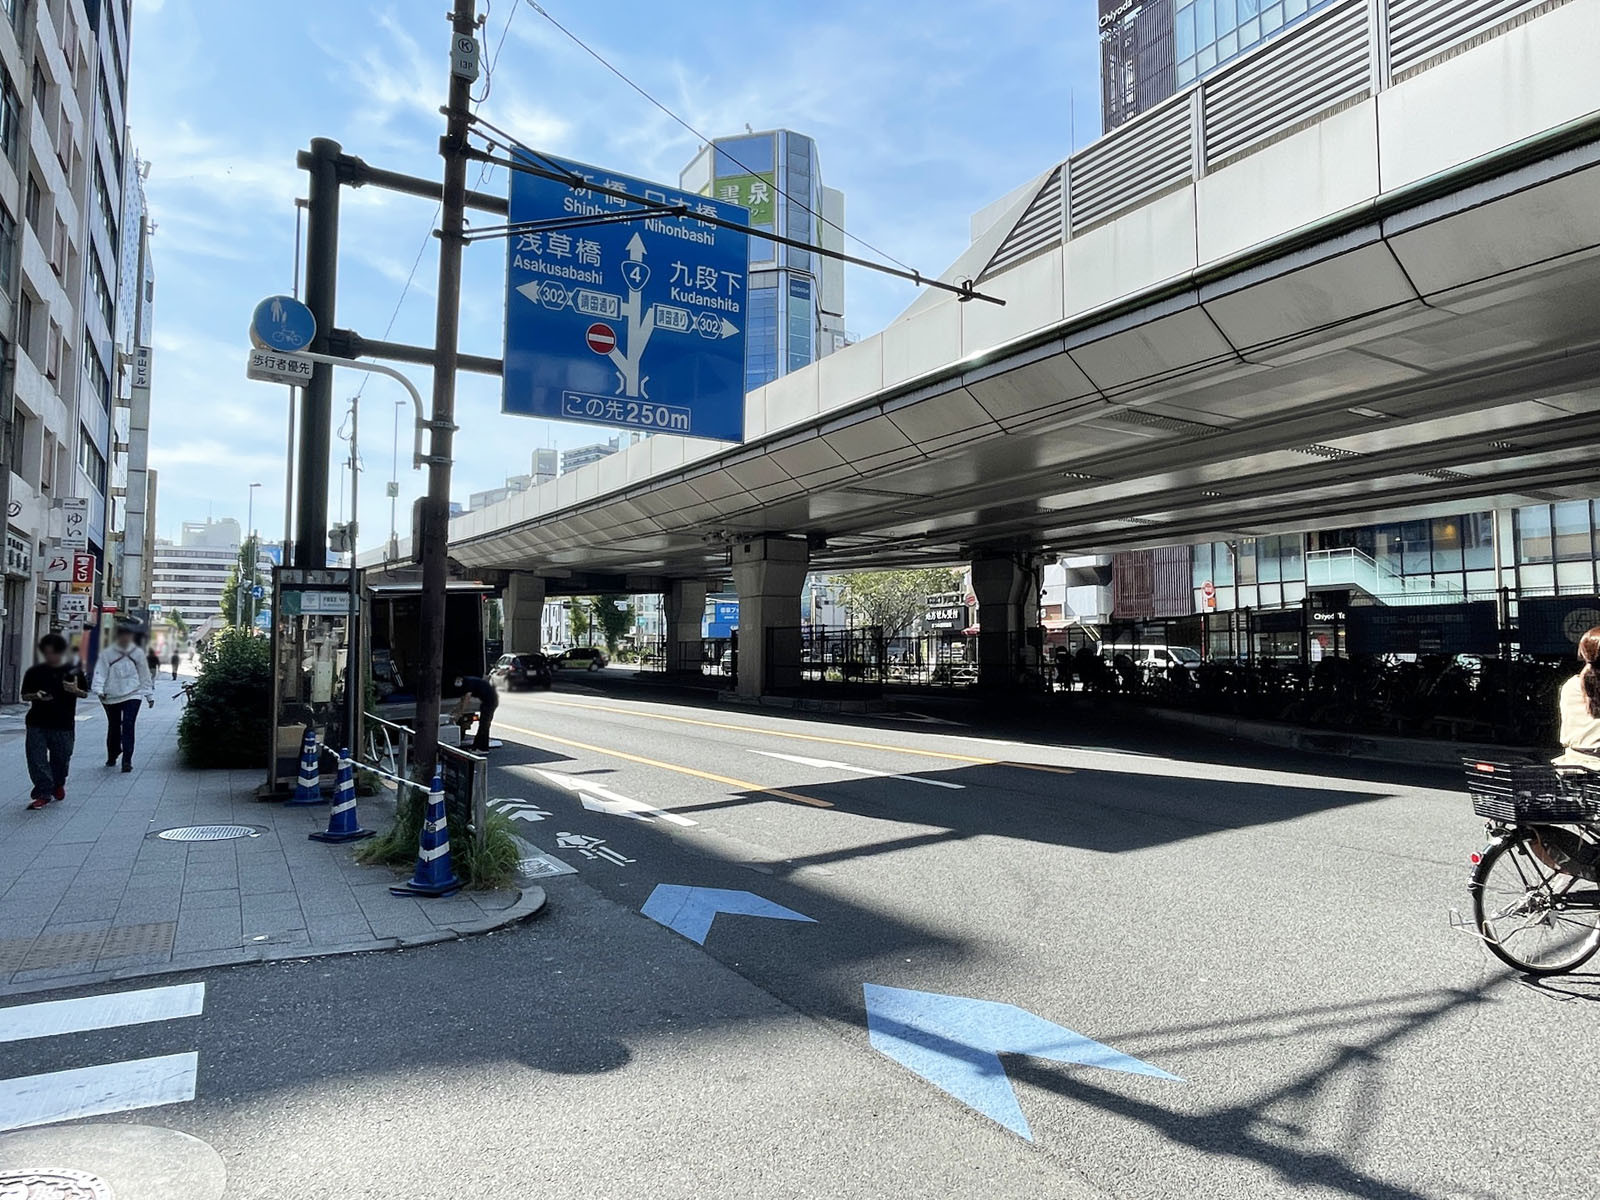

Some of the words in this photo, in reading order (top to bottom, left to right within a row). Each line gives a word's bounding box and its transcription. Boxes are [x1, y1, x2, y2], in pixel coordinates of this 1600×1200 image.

[644, 219, 715, 247] Nihonbashi
[516, 228, 602, 267] 浅草橋
[512, 254, 603, 285] Asakusabashi
[629, 266, 641, 283] 4
[669, 260, 743, 296] 九段下
[542, 287, 565, 304] 302
[671, 287, 740, 313] Kudanshita
[699, 319, 719, 333] 302
[253, 354, 310, 375] 歩行者優先
[565, 395, 690, 430] この先250m
[66, 512, 83, 537] ゆい
